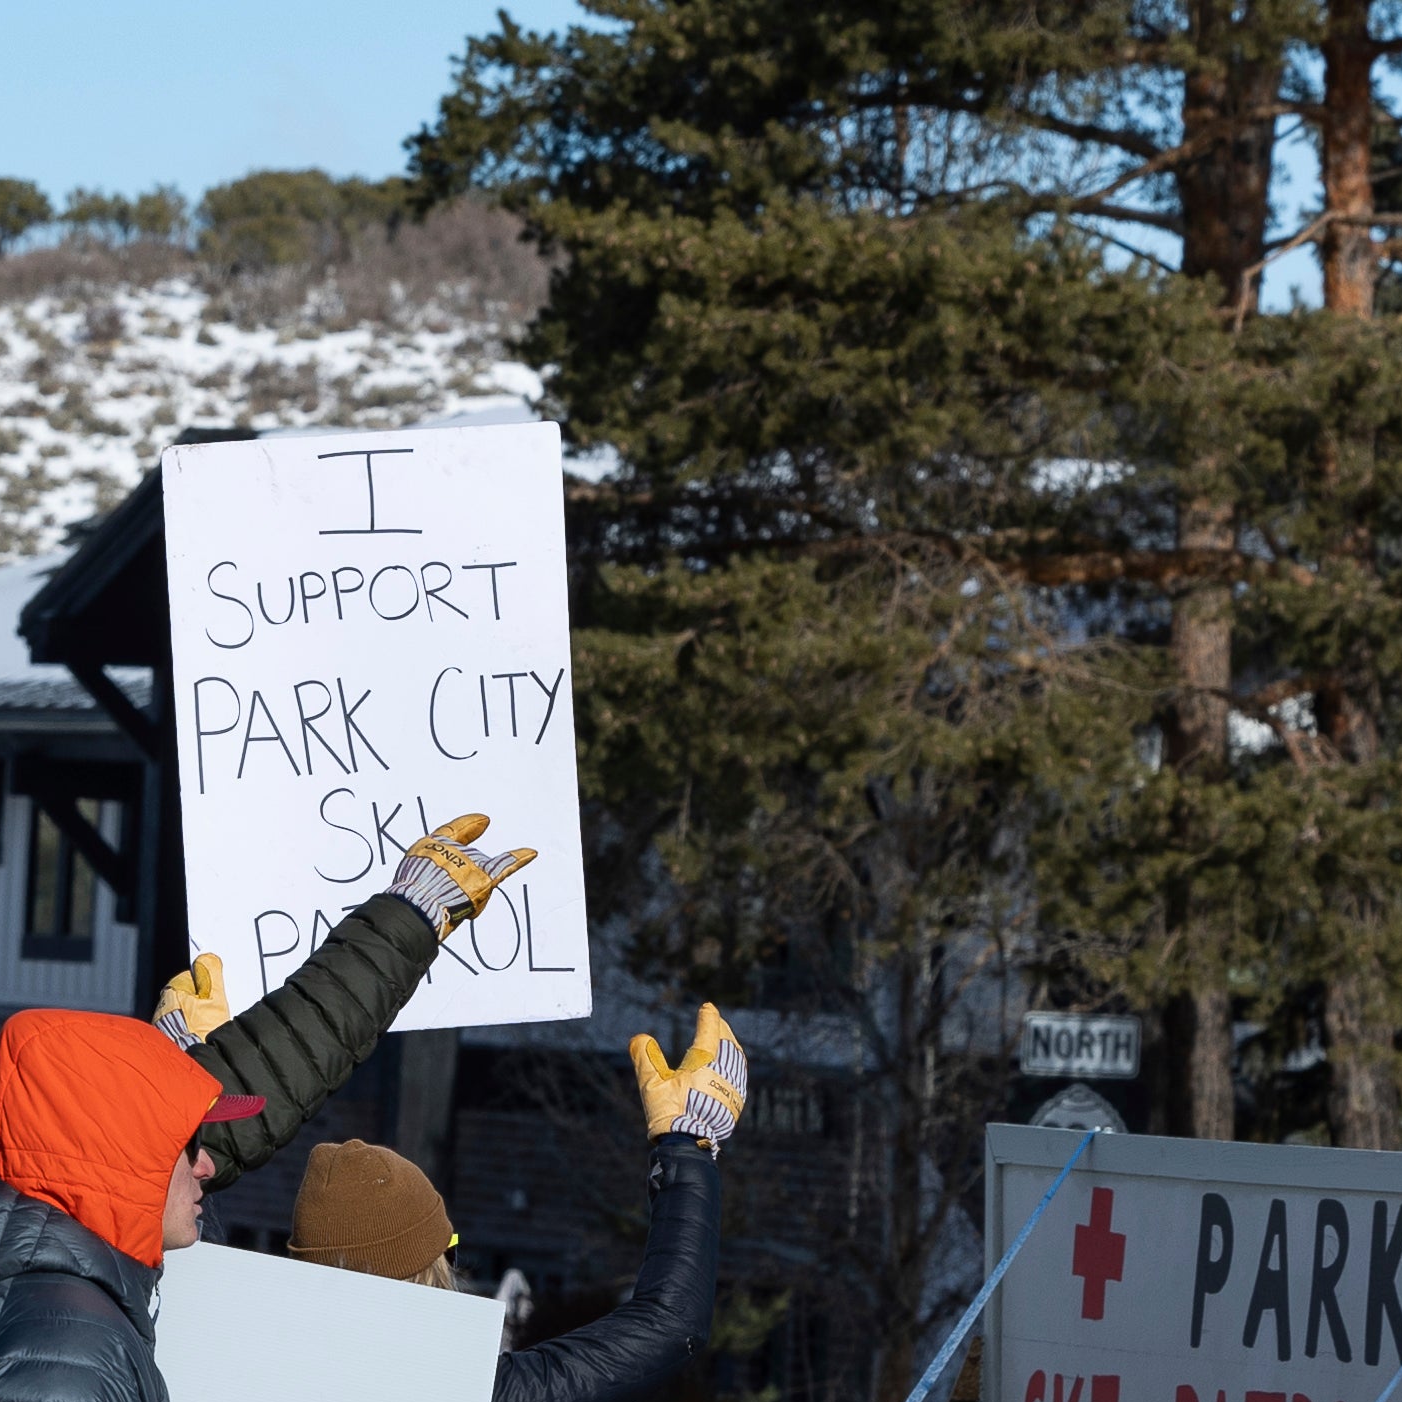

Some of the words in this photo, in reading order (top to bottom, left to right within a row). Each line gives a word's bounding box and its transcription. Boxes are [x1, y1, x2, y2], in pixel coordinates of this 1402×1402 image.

[318, 448, 422, 535] I
[205, 561, 517, 649] SUPPORT
[193, 676, 389, 795] PARK
[429, 666, 565, 761] CITY
[425, 843, 467, 869] KINCO
[1032, 1025, 1132, 1062] NORTH
